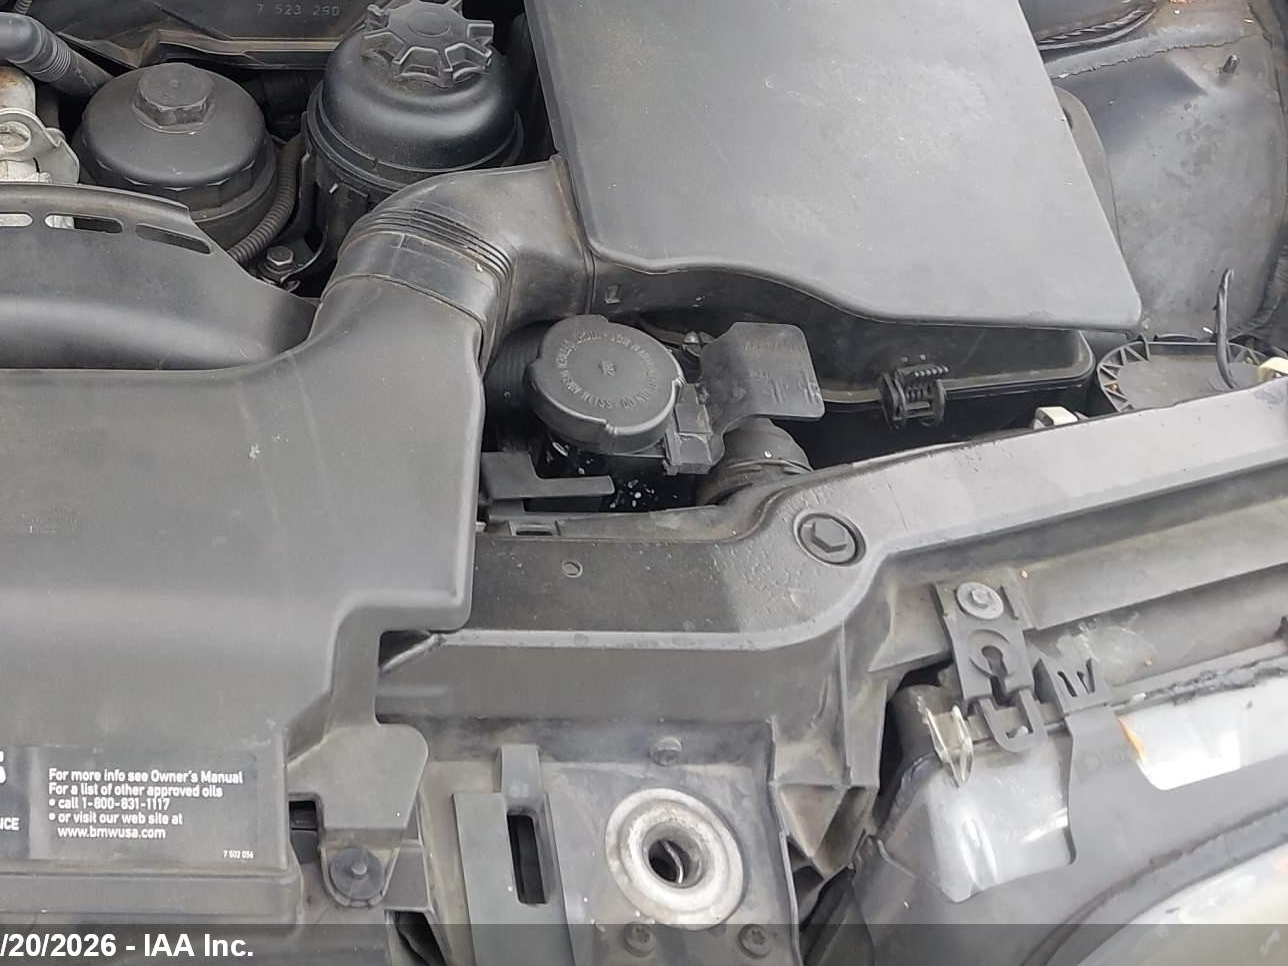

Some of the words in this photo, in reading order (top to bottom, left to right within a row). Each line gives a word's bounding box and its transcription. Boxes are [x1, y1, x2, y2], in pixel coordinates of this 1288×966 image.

[256, 4, 264, 15] 7
[275, 4, 303, 16] 523
[48, 768, 69, 781] For
[71, 770, 101, 782] more
[104, 769, 126, 782] info
[128, 771, 148, 782] see
[150, 769, 198, 783] Owner's
[200, 770, 243, 784] Manual
[48, 782, 69, 796] For
[70, 786, 79, 796] a
[80, 783, 98, 796] list
[100, 783, 112, 796] of
[114, 783, 145, 797] other
[147, 785, 200, 799] approved
[202, 785, 223, 798] oils
[58, 797, 79, 809] call
[81, 797, 171, 811] 1-800-831-1117
[58, 813, 71, 824] or
[73, 812, 97, 824] visit
[99, 813, 120, 824] our
[121, 813, 146, 825] web
[148, 813, 169, 825] site
[171, 813, 183, 825] at
[57, 826, 166, 839] www.bmwusa.com
